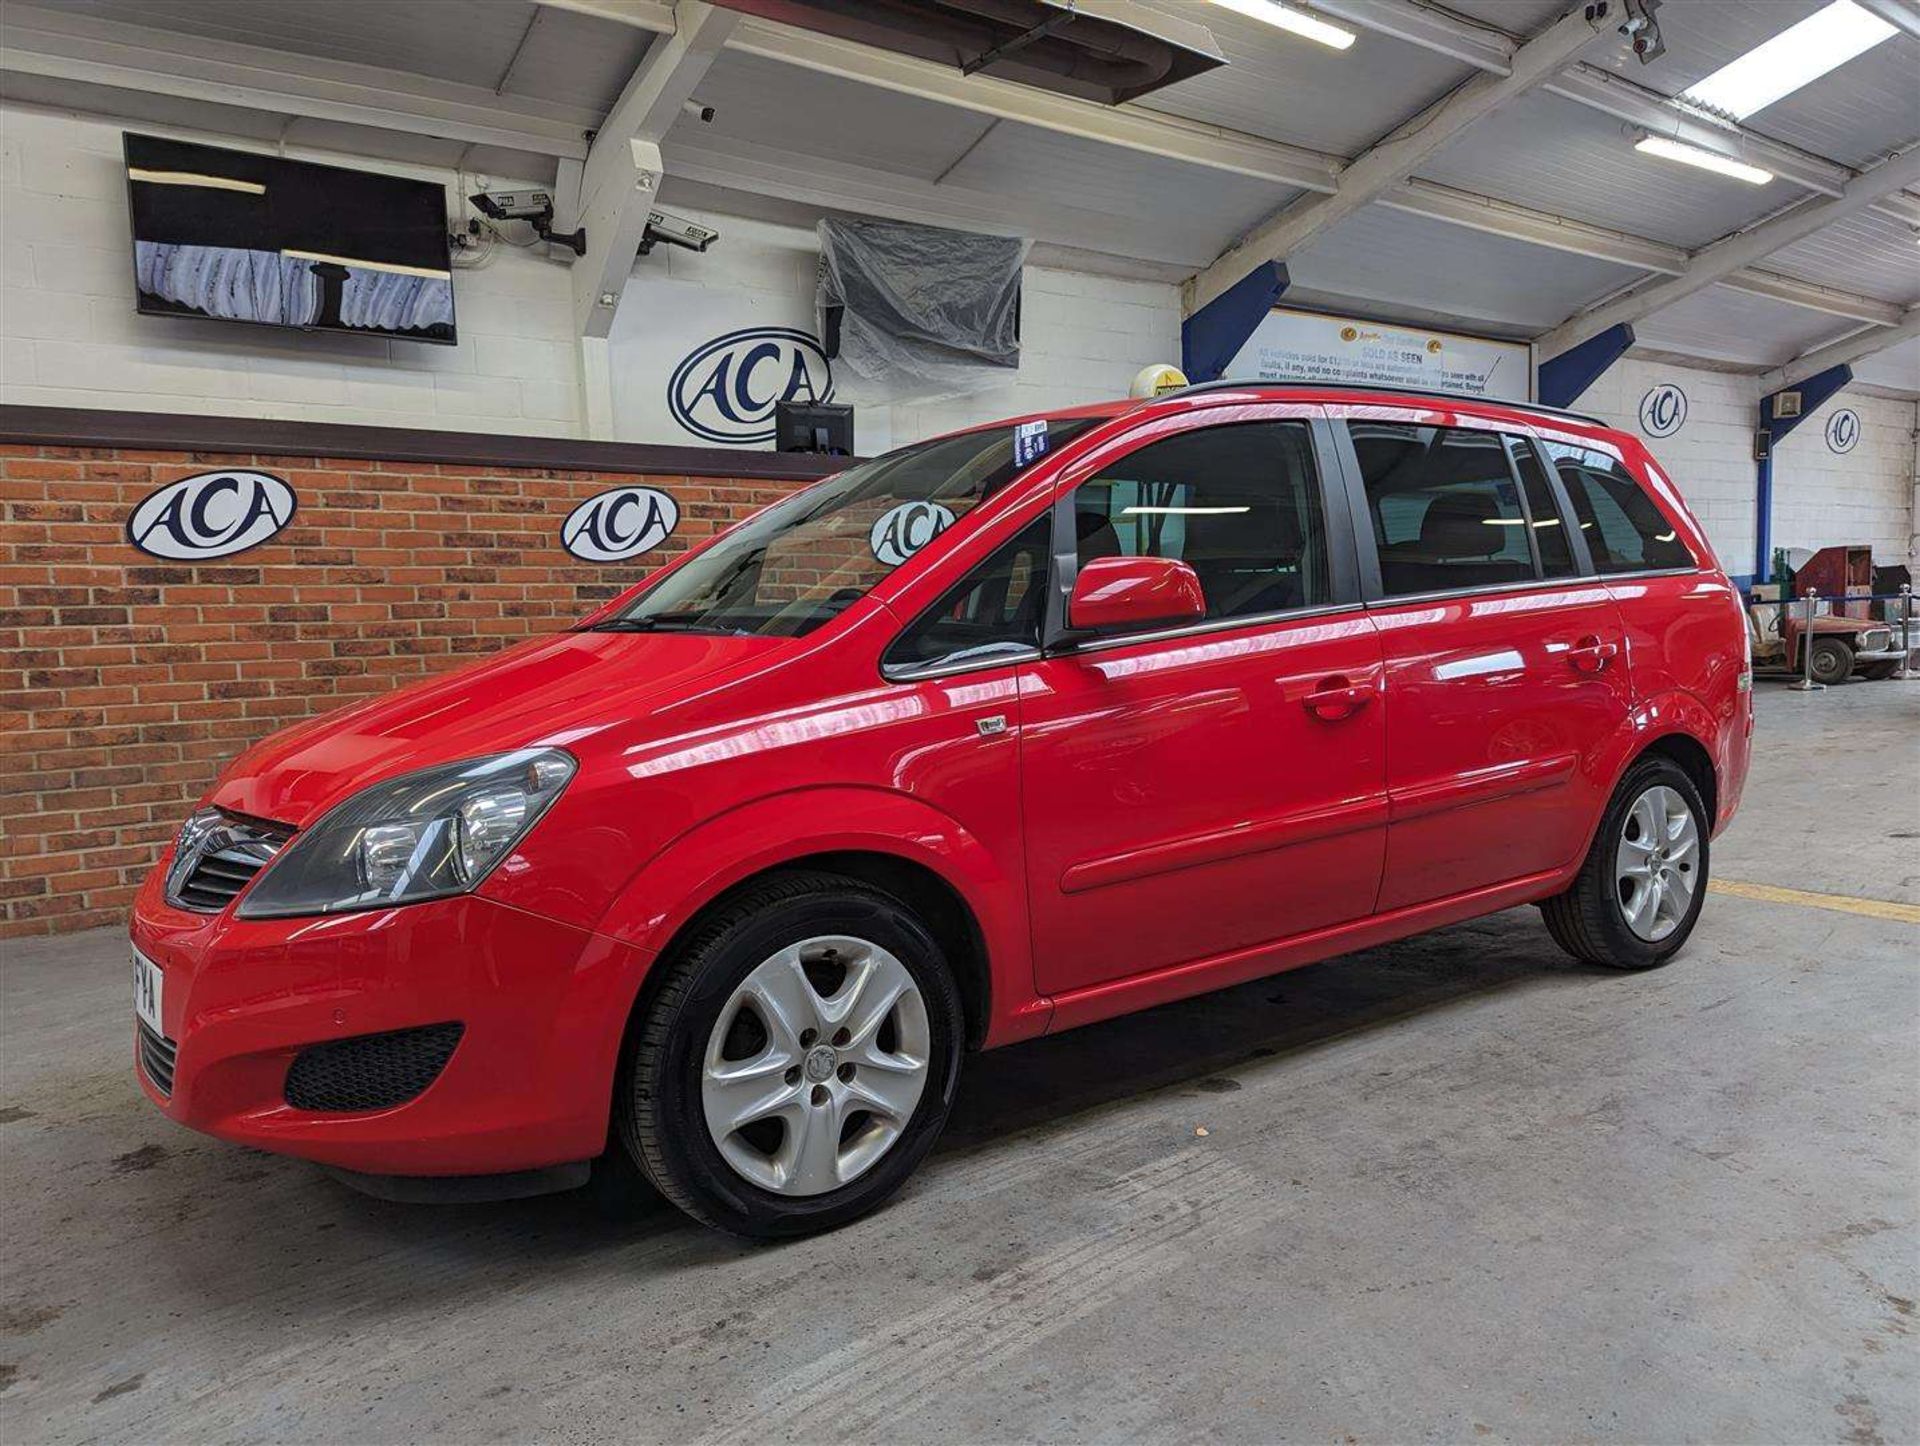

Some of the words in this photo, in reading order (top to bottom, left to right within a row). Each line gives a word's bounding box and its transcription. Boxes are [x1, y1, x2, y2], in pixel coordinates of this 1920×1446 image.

[1291, 364, 1306, 374] any,
[1308, 365, 1320, 374] and
[1322, 367, 1331, 375] no
[1369, 371, 1404, 382] whatsoever
[1301, 353, 1316, 362] sold
[1318, 354, 1328, 363] for
[1388, 350, 1399, 361] AS
[1401, 351, 1423, 364] SEEN
[686, 343, 816, 423] ACA
[1643, 391, 1680, 430] ACA
[1829, 414, 1854, 447] ACA
[137, 477, 282, 549] ACA
[568, 492, 669, 553] ACA
